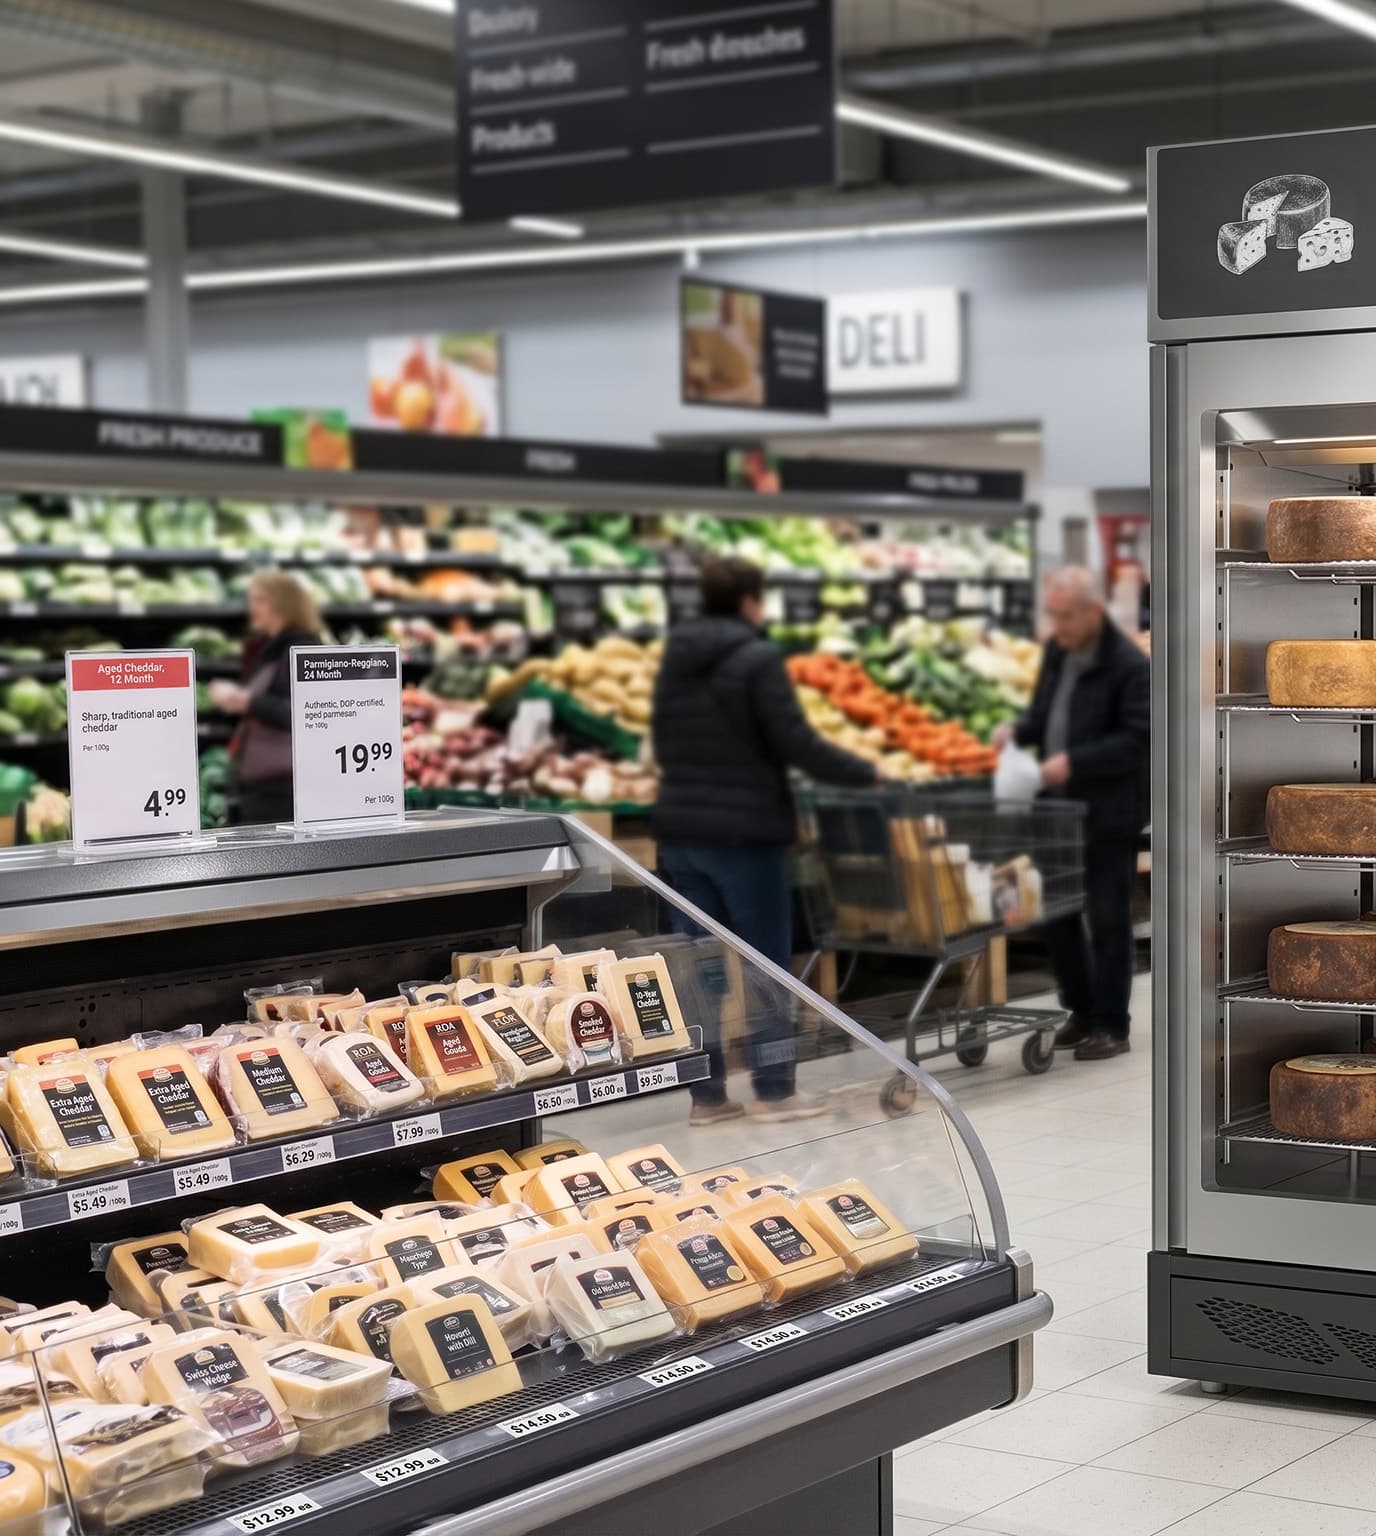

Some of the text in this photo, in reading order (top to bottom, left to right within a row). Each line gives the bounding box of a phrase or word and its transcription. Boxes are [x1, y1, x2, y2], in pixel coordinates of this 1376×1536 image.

[838, 309, 925, 370] DELI
[98, 420, 262, 455] FRESH PRODUCE
[98, 662, 165, 675] Aged Cheddar,
[304, 658, 389, 673] Parmigiano-Reggiano,
[110, 674, 154, 684] 12 Month
[304, 669, 342, 680] 24 Month
[304, 700, 339, 710] Authentic,
[356, 698, 385, 707] certified,
[82, 709, 177, 723] Sharp, traditional aged
[304, 709, 357, 720] aged parmesan
[82, 723, 118, 733] cheddar
[315, 722, 328, 730] 100g
[95, 744, 110, 752] 100g
[365, 795, 394, 804] Per 100g
[635, 989, 657, 1000] 10-Year
[636, 998, 661, 1009] Cheddar
[391, 1022, 406, 1031] RO
[434, 1022, 456, 1033] ROA
[578, 1016, 603, 1029] Smoked
[579, 1026, 605, 1037] Cheddar
[442, 1036, 461, 1048] Aged
[352, 1045, 376, 1058] ROA
[443, 1045, 467, 1056] Gouda
[365, 1059, 383, 1070] Aged
[251, 1066, 283, 1079] Medium
[368, 1066, 391, 1077] Gouda
[256, 1074, 287, 1086] Cheddar
[641, 1074, 663, 1087] $9.50
[148, 1081, 191, 1097] Extra Aged
[592, 1084, 615, 1098] $6.00
[49, 1092, 95, 1108] Extra Aged
[158, 1091, 190, 1104] Cheddar
[537, 1096, 562, 1110] $6.50
[59, 1102, 94, 1116] Cheddar
[397, 1126, 423, 1141] $7.99
[285, 1150, 315, 1166] $6.29
[178, 1173, 210, 1190] $5.49
[73, 1195, 107, 1214] $5.49
[411, 1260, 428, 1270] Type
[591, 1280, 631, 1296] Old World Brie
[835, 1302, 871, 1318] $14.50
[447, 1336, 477, 1352] with Dill
[751, 1331, 790, 1348] $14.50
[185, 1358, 239, 1381] Swiss Cheese
[651, 1365, 694, 1383] $14.50
[202, 1371, 232, 1387] Wedge
[511, 1413, 557, 1433] $14.50
[376, 1460, 424, 1482] $12.99
[243, 1505, 295, 1529] $12.99
[298, 1503, 312, 1511] ea
